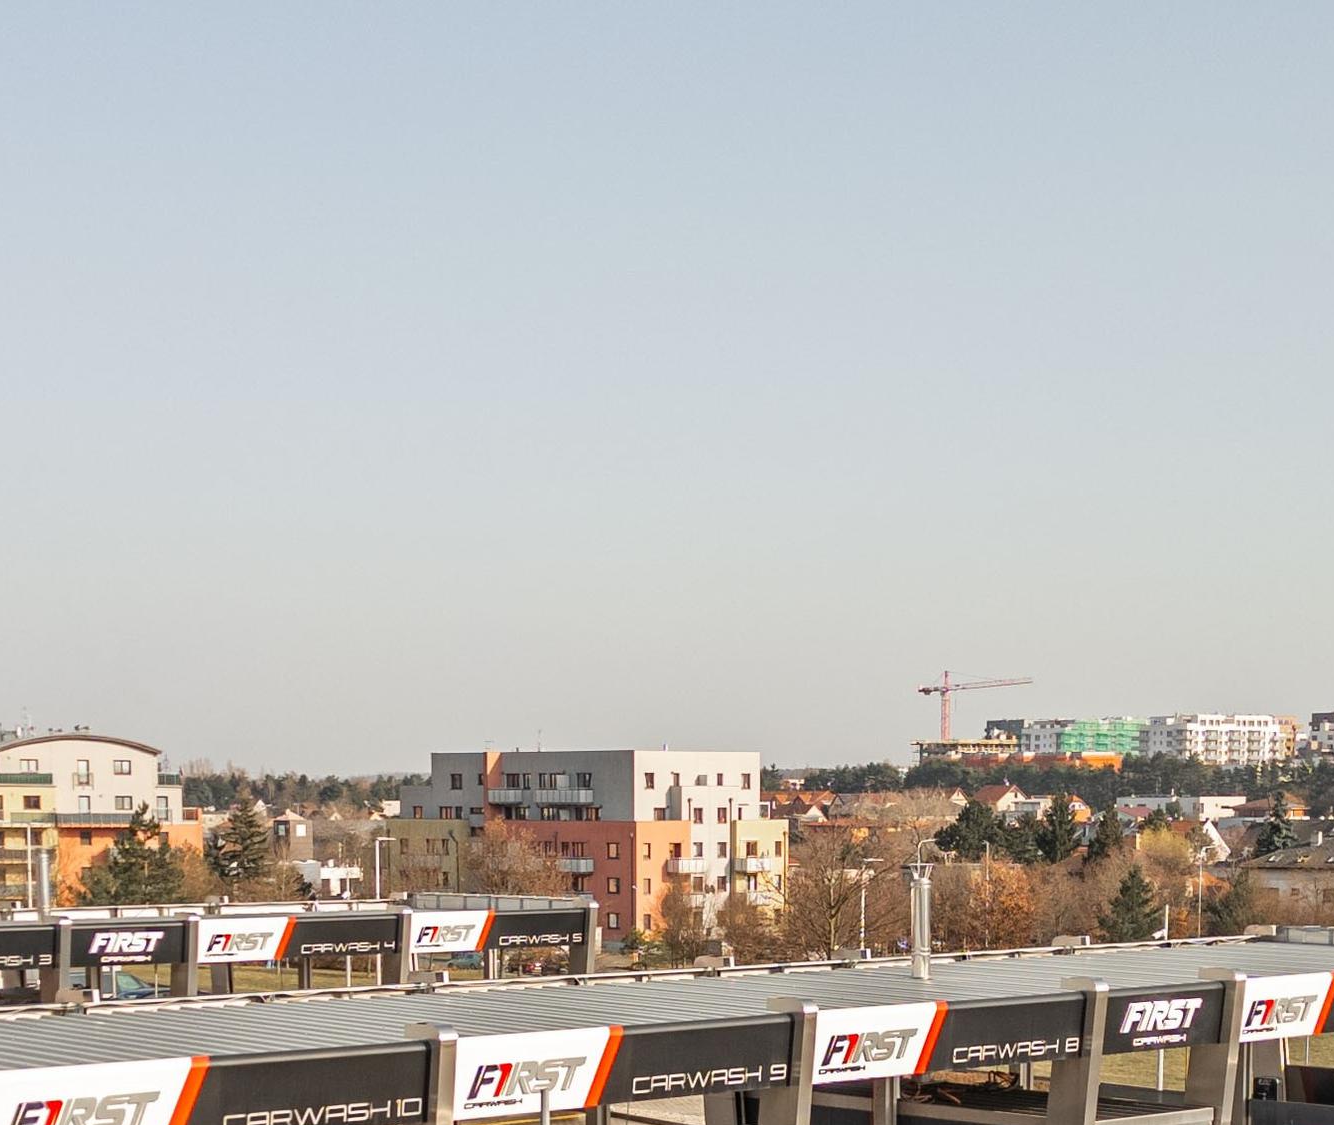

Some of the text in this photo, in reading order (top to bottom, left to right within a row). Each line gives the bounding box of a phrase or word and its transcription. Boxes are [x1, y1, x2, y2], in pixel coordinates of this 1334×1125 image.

[301, 941, 395, 955] CARWASH 4
[499, 934, 583, 946] CARWASH 5
[39, 954, 53, 965] 3
[953, 1037, 1079, 1063] CARWASH 8
[633, 1063, 787, 1095] CARWASH 9
[395, 1097, 423, 1117] 10
